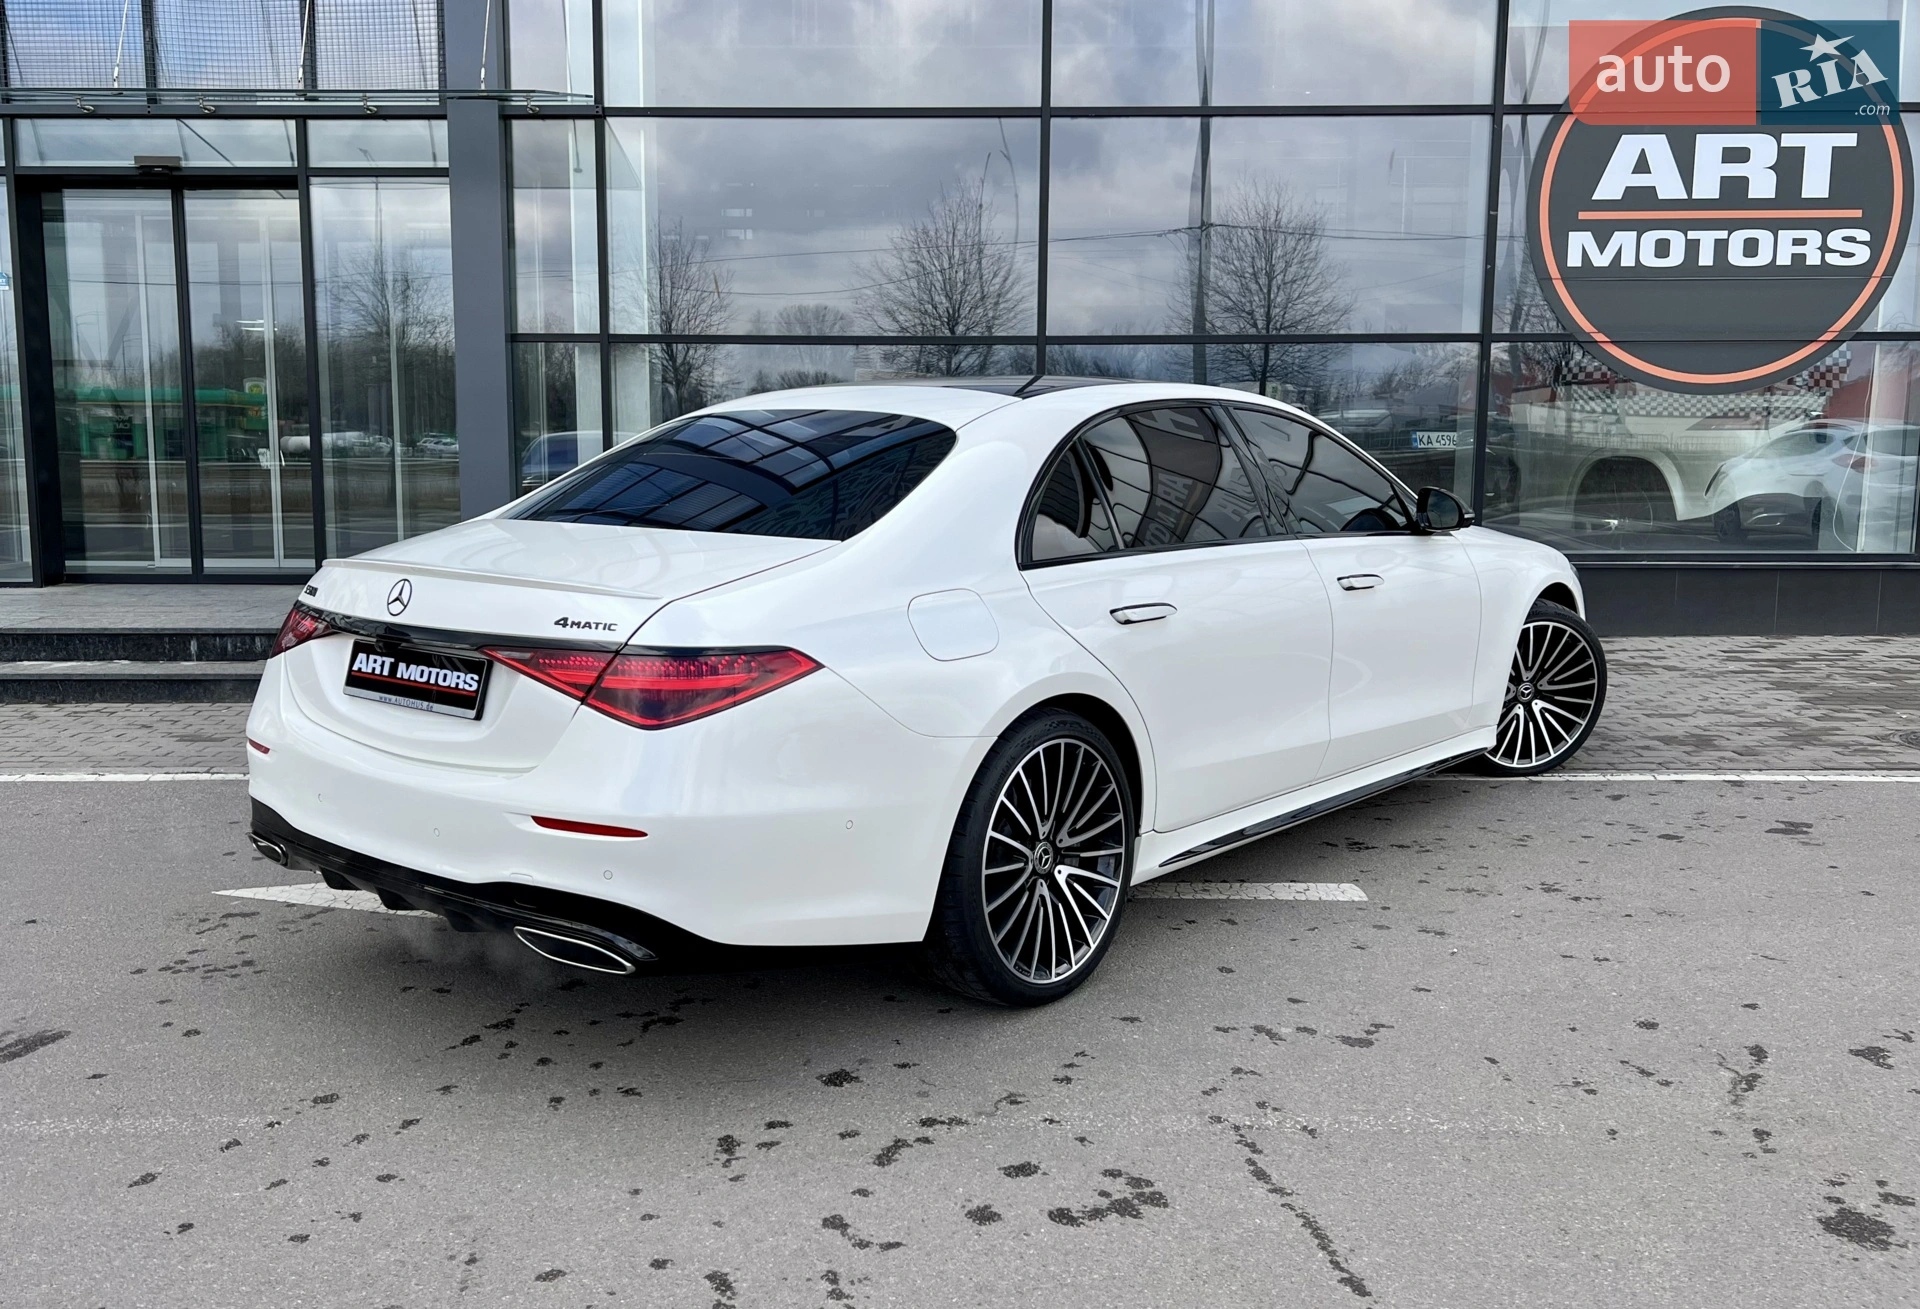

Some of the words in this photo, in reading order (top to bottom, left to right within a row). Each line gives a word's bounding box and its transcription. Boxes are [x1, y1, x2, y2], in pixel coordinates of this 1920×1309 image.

[1591, 133, 1858, 200] ART
[1566, 229, 1872, 268] MOTORS
[1418, 434, 1434, 446] KA
[554, 617, 618, 631] 4MATIC
[352, 653, 395, 676] ART
[396, 662, 479, 691] MOTORS
